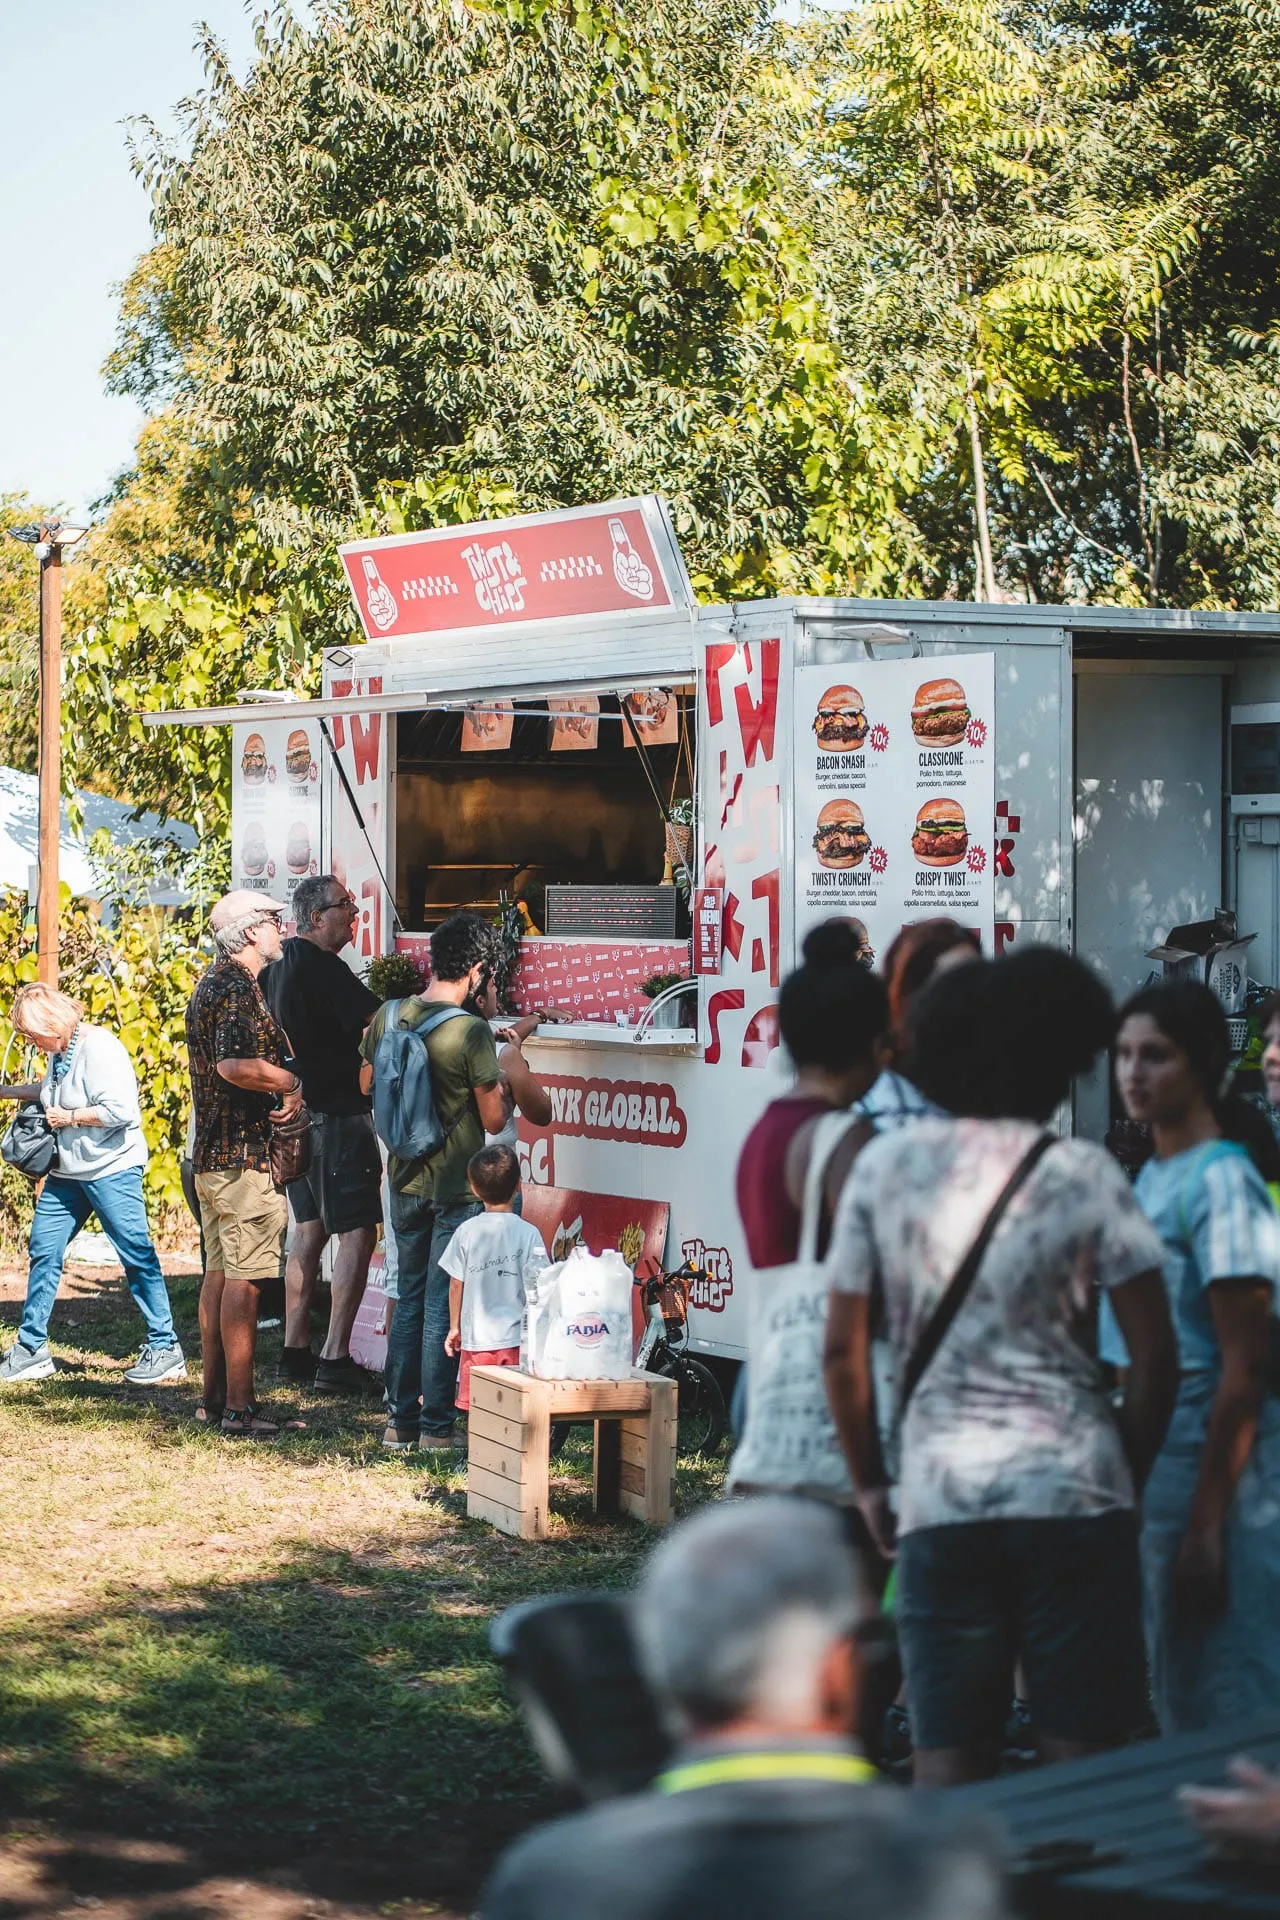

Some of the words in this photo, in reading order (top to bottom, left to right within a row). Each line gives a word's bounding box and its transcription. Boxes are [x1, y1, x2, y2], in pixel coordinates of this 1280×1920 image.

[816, 755, 840, 770] BACON
[841, 754, 865, 769] SMASH
[919, 751, 963, 767] CLASSICONE
[811, 872, 837, 886] TWISTY
[838, 872, 872, 886] CRUNCHY
[915, 871, 941, 886] CRISPY
[943, 871, 966, 886] TWIST
[1225, 961, 1233, 1000] PERONI
[584, 1090, 681, 1135] GLOBAL.
[566, 1322, 610, 1338] FABIA
